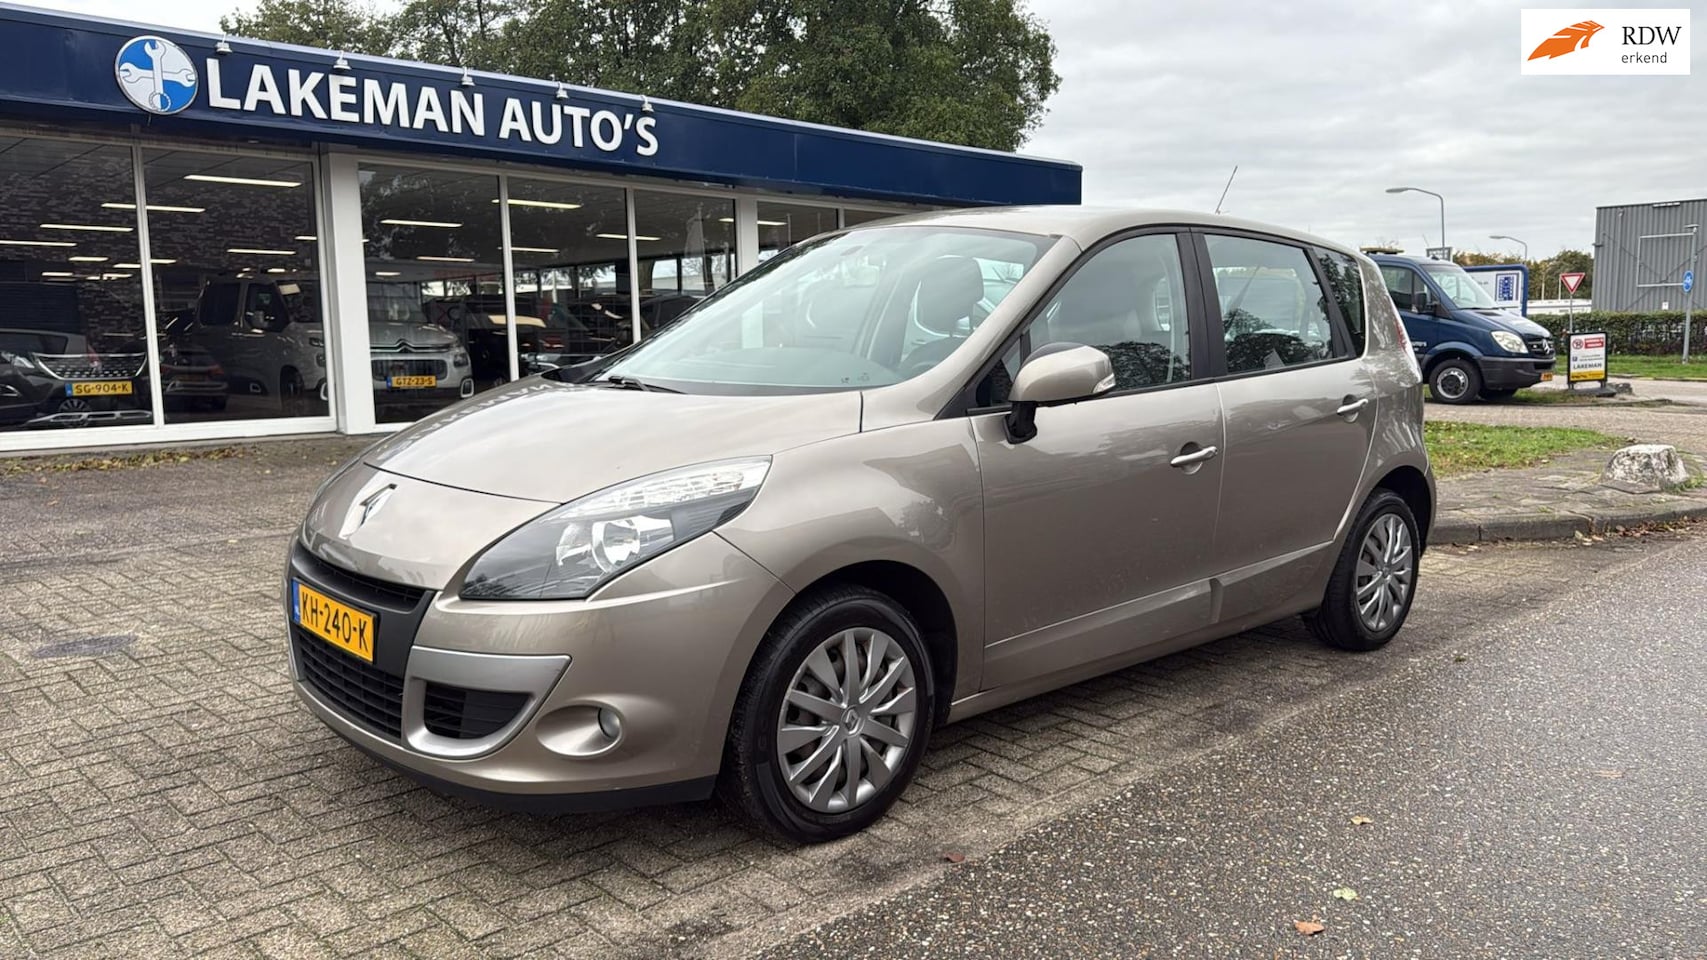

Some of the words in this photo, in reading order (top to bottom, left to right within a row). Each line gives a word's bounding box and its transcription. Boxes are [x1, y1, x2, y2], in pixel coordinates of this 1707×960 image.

[206, 57, 486, 137] LAKEMAN
[498, 97, 659, 157] AUTO'S
[1573, 362, 1602, 370] LAKEMAN
[395, 376, 433, 386] GTZ-23-S
[75, 383, 129, 395] SG-904-K
[302, 591, 369, 653] KH-240-K
